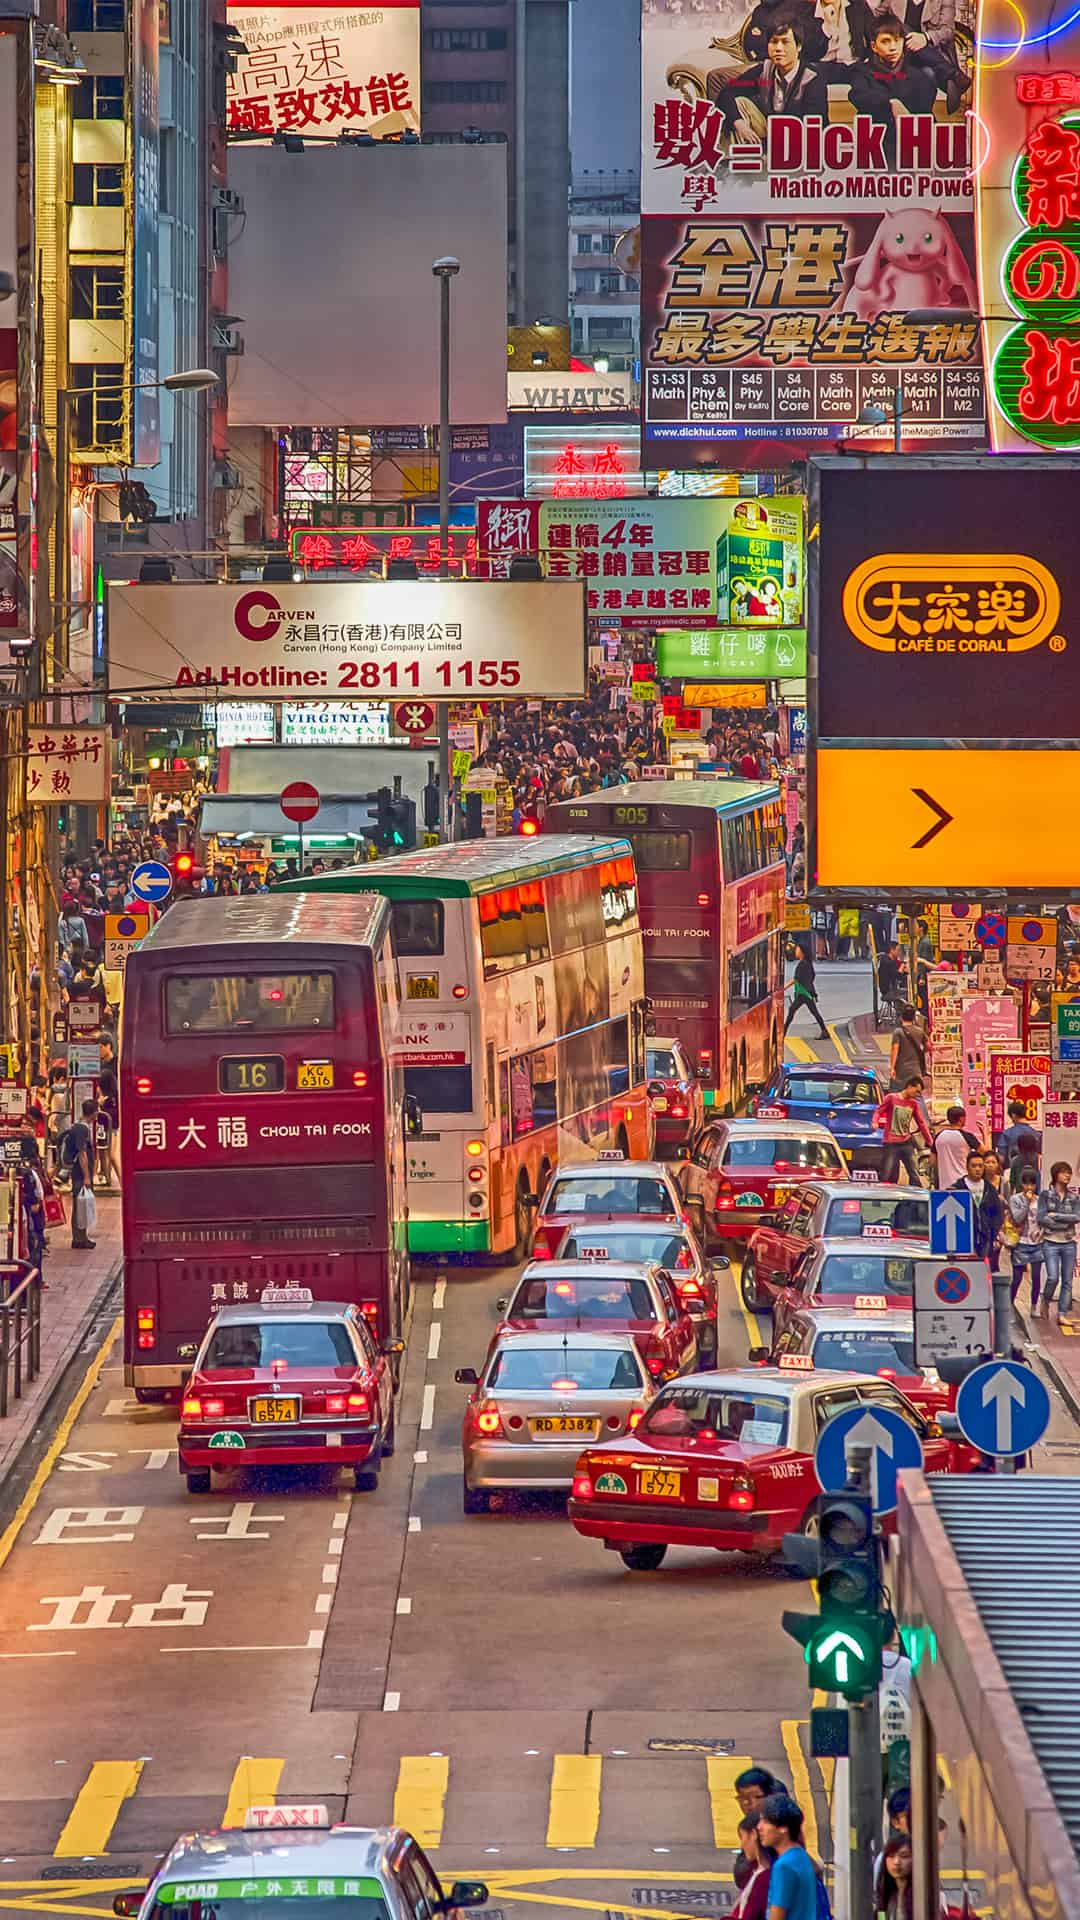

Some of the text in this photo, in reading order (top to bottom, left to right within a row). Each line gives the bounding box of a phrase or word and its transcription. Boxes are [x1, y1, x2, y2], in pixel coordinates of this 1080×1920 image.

[227, 72, 412, 134] 極致效能
[768, 115, 886, 171] Dick
[900, 115, 971, 171] Hu
[664, 222, 849, 310] 全港
[651, 312, 977, 363] 最多學生選報
[702, 374, 716, 384] S3
[742, 374, 762, 384] S45
[787, 374, 801, 384] S4
[829, 373, 844, 384] S5
[872, 373, 886, 384] S6
[523, 387, 625, 407] WHAT'S
[652, 388, 685, 399] Math
[692, 387, 716, 400] Phy
[740, 388, 763, 400] Phy
[778, 387, 811, 399] Math
[820, 387, 853, 398] Math
[862, 387, 895, 398] Math
[904, 387, 938, 398] Math
[946, 387, 980, 398] Math
[691, 400, 728, 411] chem
[779, 400, 809, 411] Core
[821, 400, 852, 411] Core
[954, 400, 973, 411] M2
[547, 519, 654, 549] 連續4年
[547, 551, 711, 577] 全港銷量冠軍
[285, 622, 463, 643] 永昌行(香港)有限公司
[283, 642, 463, 654] Carven (Hong Kong) Company Limited
[898, 636, 935, 652] CAFÉ
[936, 639, 956, 652] DE
[958, 639, 1006, 652] CORAL
[222, 663, 329, 688] Hotline:
[337, 661, 421, 689] 2811
[436, 660, 522, 688] 1155
[286, 714, 369, 723] VIRGINIA
[615, 807, 648, 824] 905
[640, 928, 711, 937] HOW TAI FOOK
[1038, 948, 1047, 959] 7
[1038, 968, 1052, 978] 12
[237, 1063, 267, 1088] 16
[306, 1066, 324, 1077] KG
[301, 1077, 331, 1087] 6316
[137, 1117, 248, 1151] 周大福
[260, 1123, 371, 1138] CHOW TAI FOOK
[601, 1151, 622, 1159] TAXI
[855, 1172, 877, 1181] TAXI
[866, 1227, 890, 1236] TAXI
[582, 1248, 607, 1257] TAXI
[855, 1296, 887, 1307] TAXI
[963, 1316, 976, 1332] 7
[780, 1356, 811, 1368] TAXI
[258, 1409, 292, 1422] 6574
[535, 1419, 553, 1431] RD
[646, 1483, 676, 1495] 577
[32, 1502, 286, 1544] 巴士
[252, 1809, 320, 1826] TAXI
[174, 1883, 219, 1901] POAD
